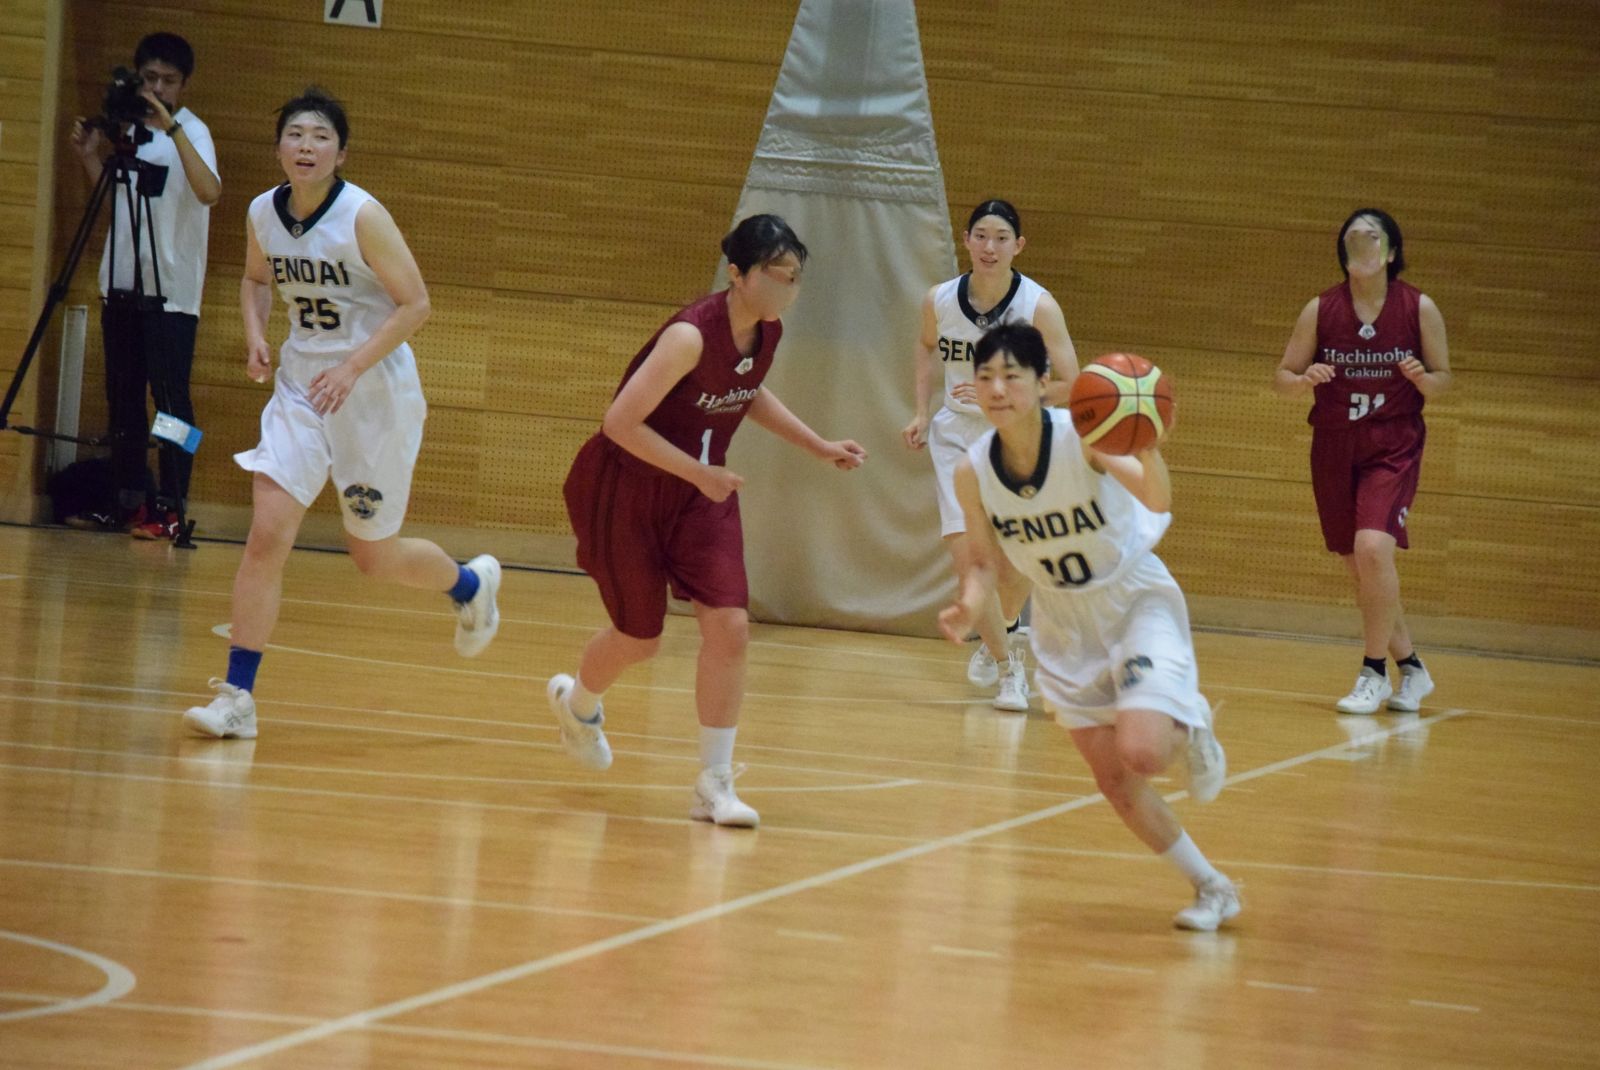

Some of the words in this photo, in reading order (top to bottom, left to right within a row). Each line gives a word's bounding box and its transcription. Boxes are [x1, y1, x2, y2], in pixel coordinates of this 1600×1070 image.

[267, 256, 350, 286] ENDAI
[294, 297, 341, 330] 25
[1344, 366, 1393, 378] Gakuin
[699, 428, 713, 466] 1
